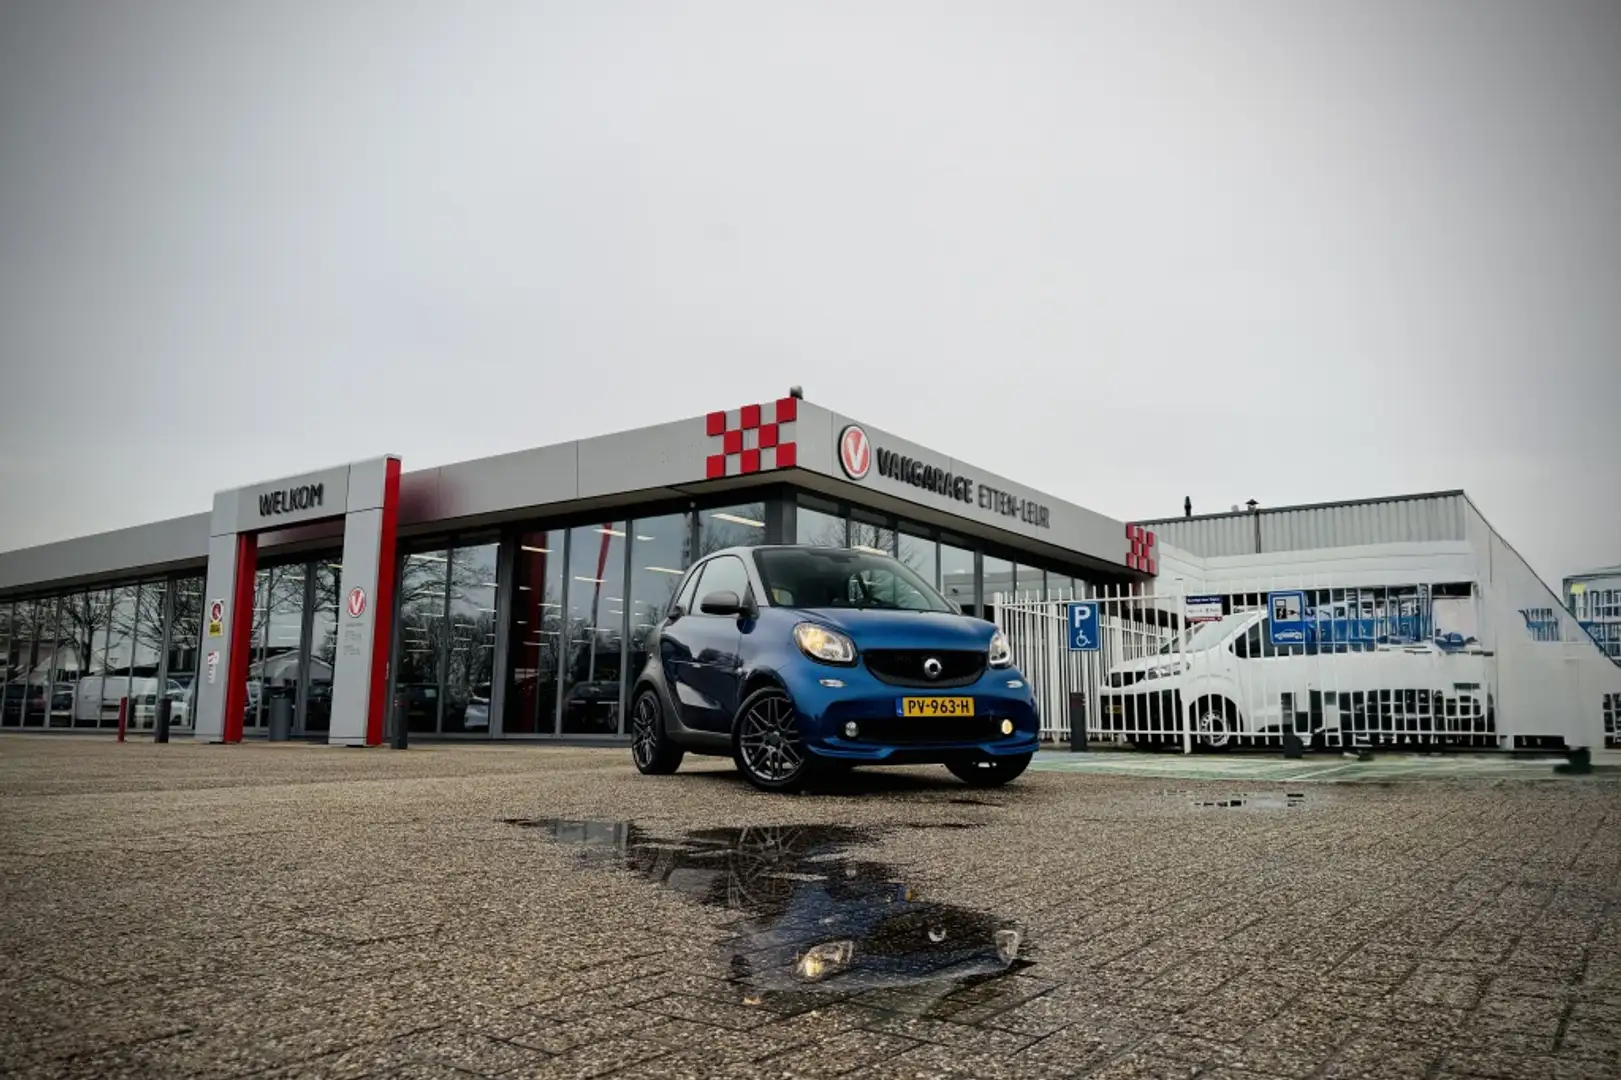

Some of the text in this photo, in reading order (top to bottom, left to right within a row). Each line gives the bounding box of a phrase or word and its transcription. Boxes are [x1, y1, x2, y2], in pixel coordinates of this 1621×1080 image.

[259, 482, 324, 517] WELKOM
[877, 447, 1050, 529] VAKGARAGE ETTEN-LEUR
[1074, 606, 1091, 628] P
[908, 699, 970, 714] PV-963-H
